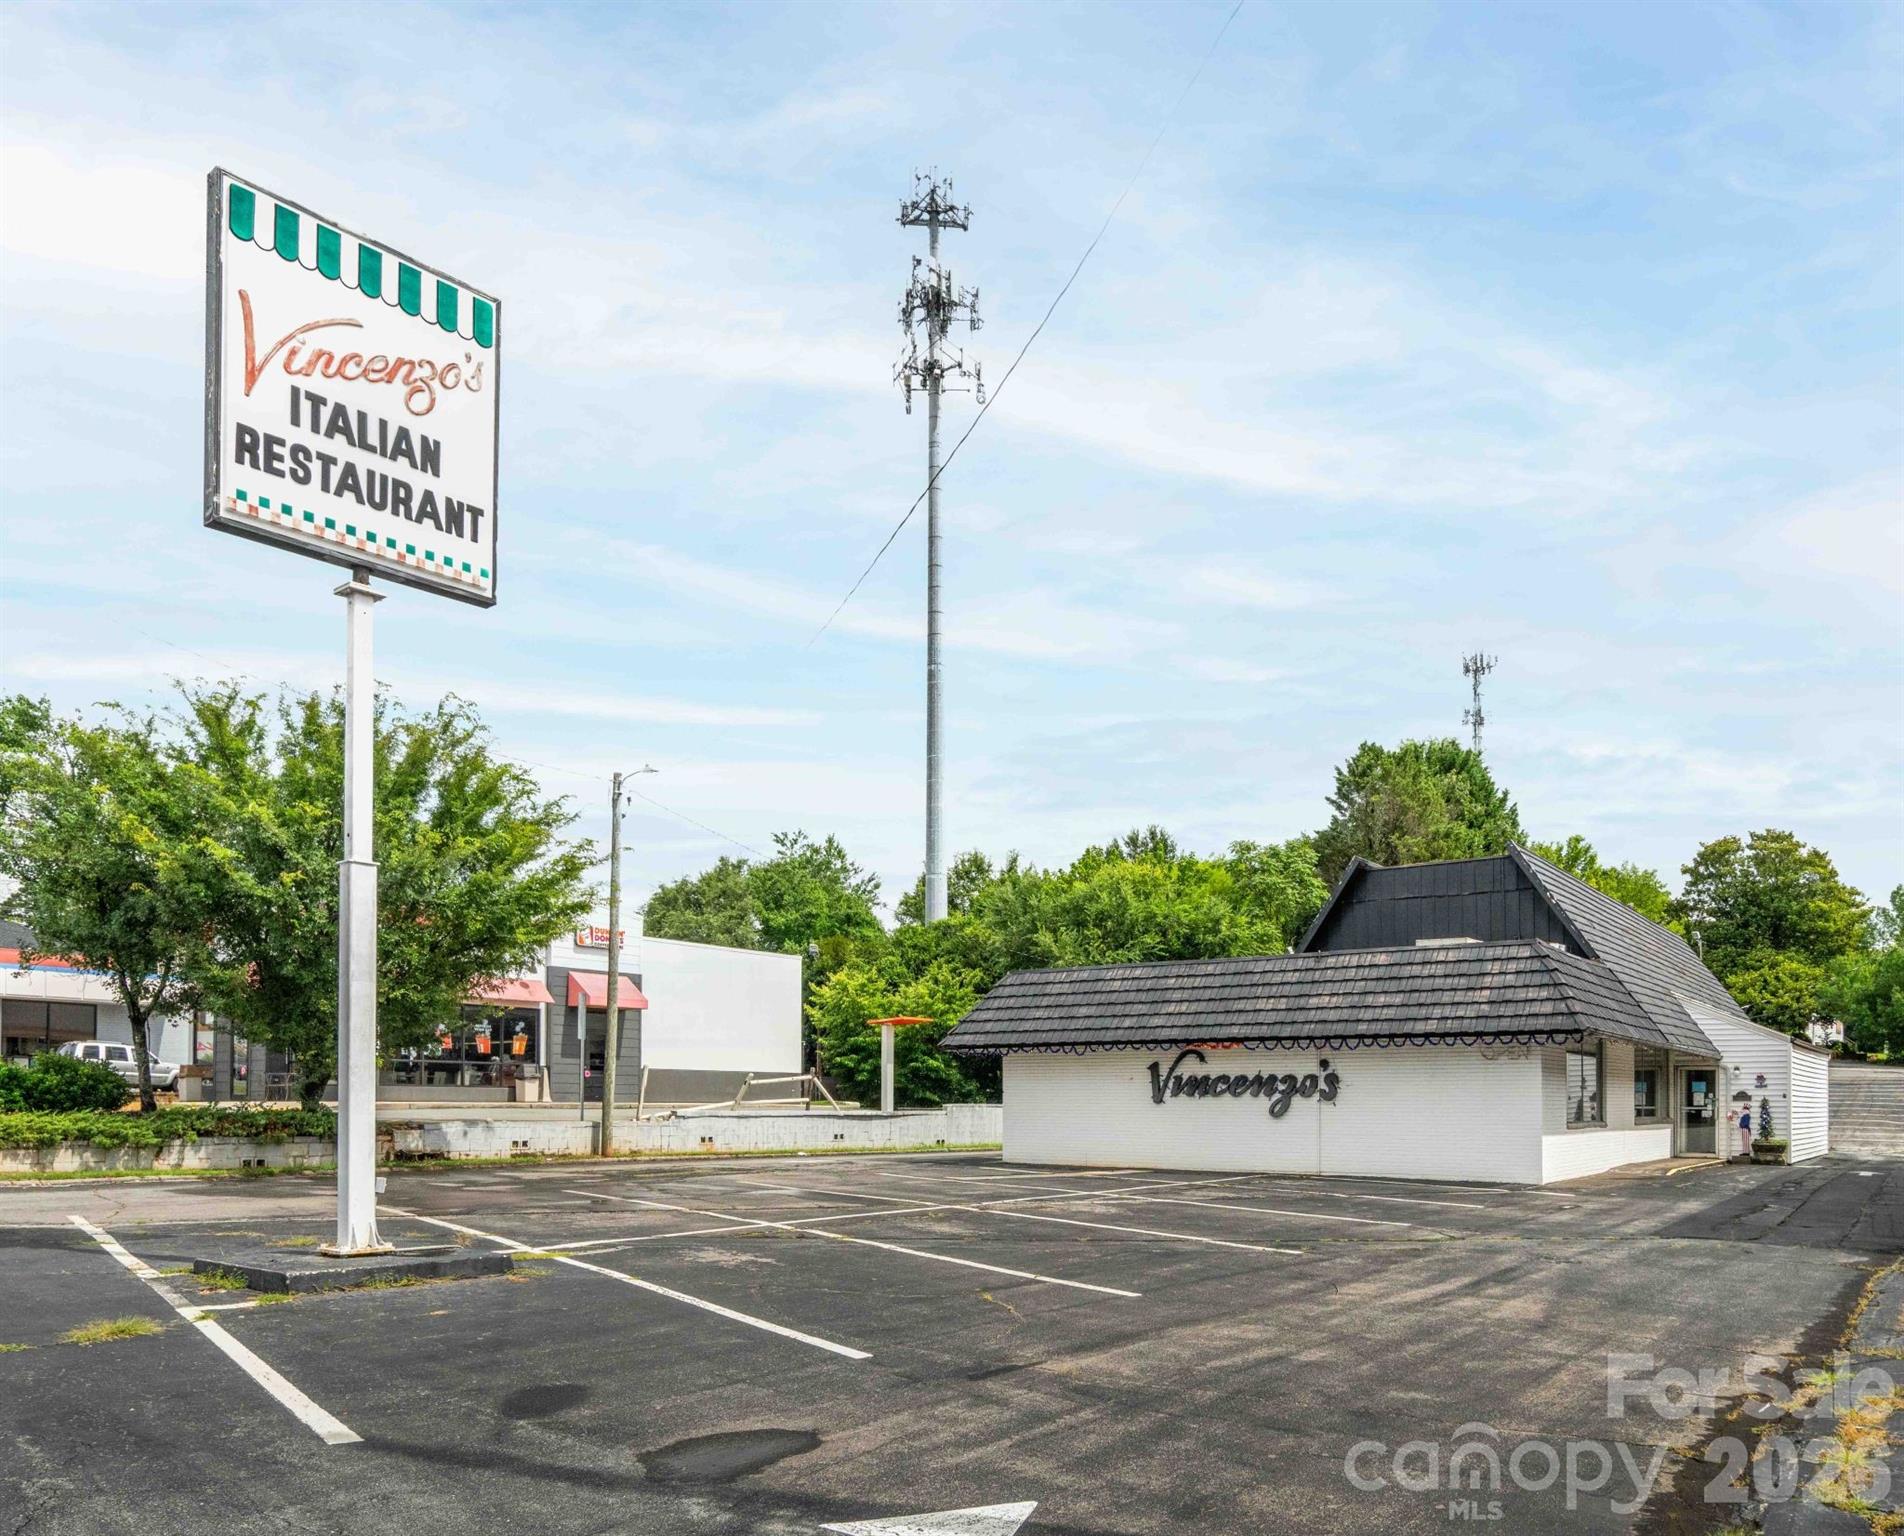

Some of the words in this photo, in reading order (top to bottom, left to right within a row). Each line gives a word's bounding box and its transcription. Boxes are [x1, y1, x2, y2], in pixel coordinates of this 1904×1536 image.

[238, 289, 484, 416] Vincenzo's
[234, 421, 485, 543] RESTAURANT
[290, 385, 441, 478] ITALIAN
[1147, 1050, 1340, 1118] Vincenzo's
